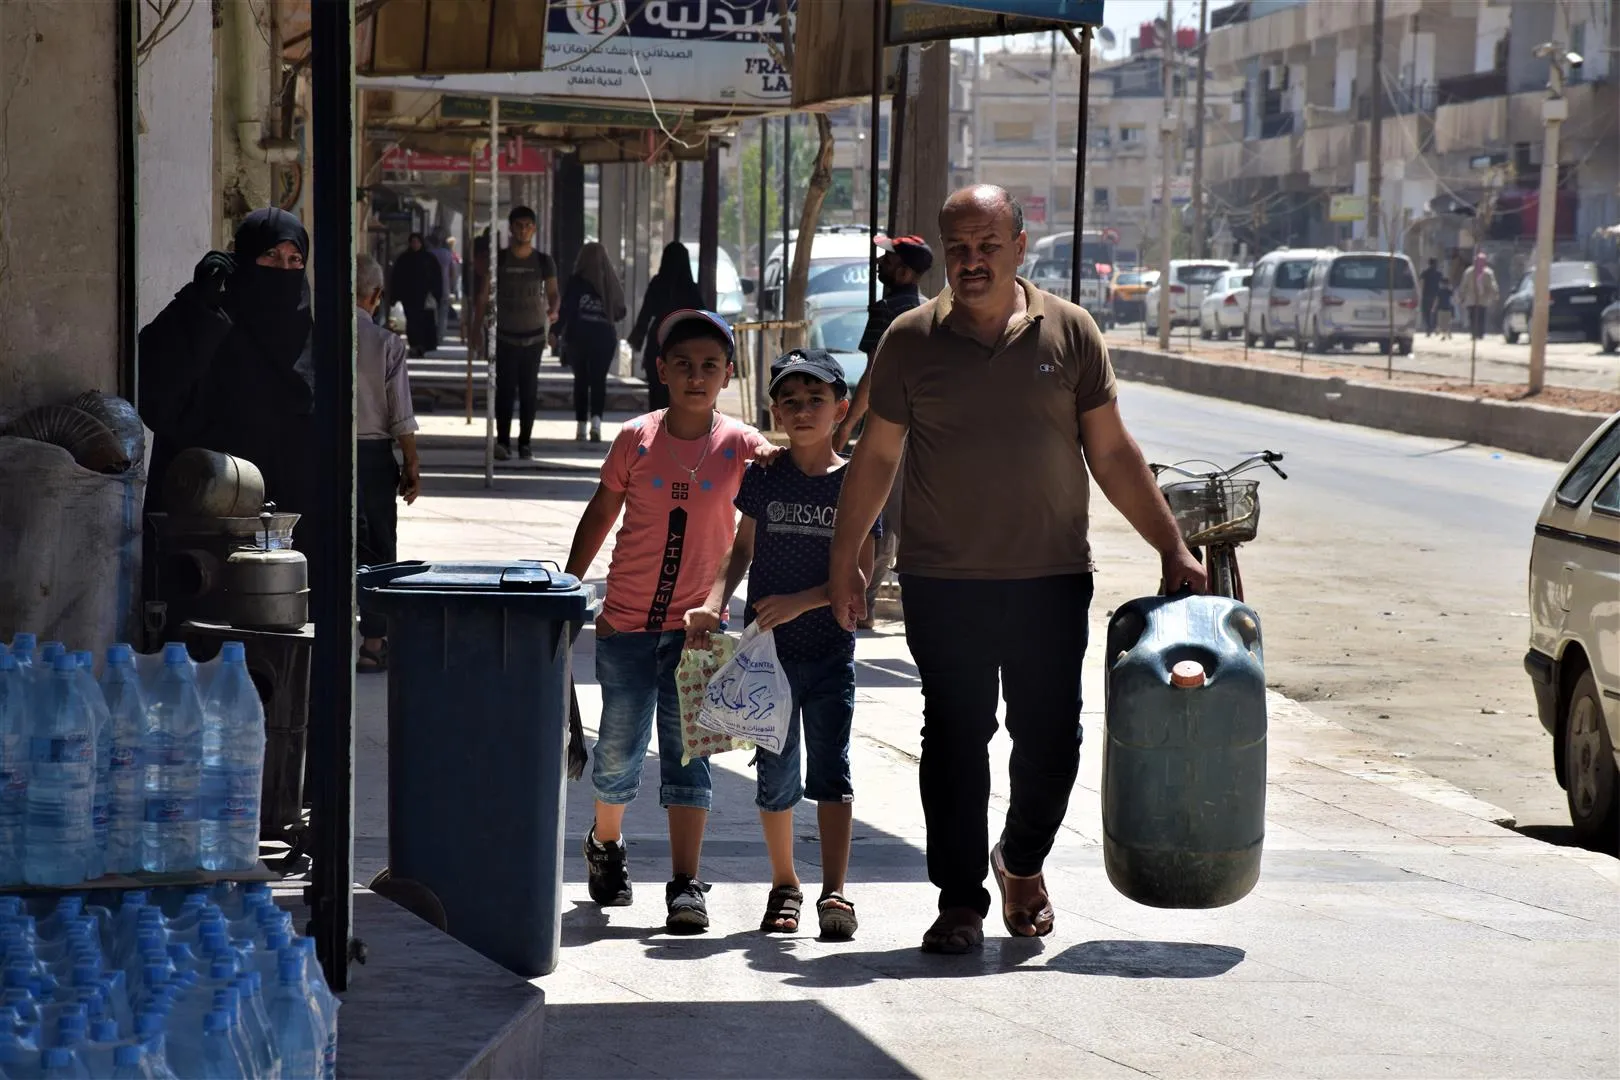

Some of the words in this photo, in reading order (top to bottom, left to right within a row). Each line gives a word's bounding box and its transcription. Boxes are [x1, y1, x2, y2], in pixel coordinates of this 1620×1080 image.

[642, 48, 693, 61] الصيدلاني
[629, 65, 652, 76] أدية
[745, 57, 789, 74] FRA
[762, 76, 792, 92] LA
[767, 501, 838, 527] ERSAC
